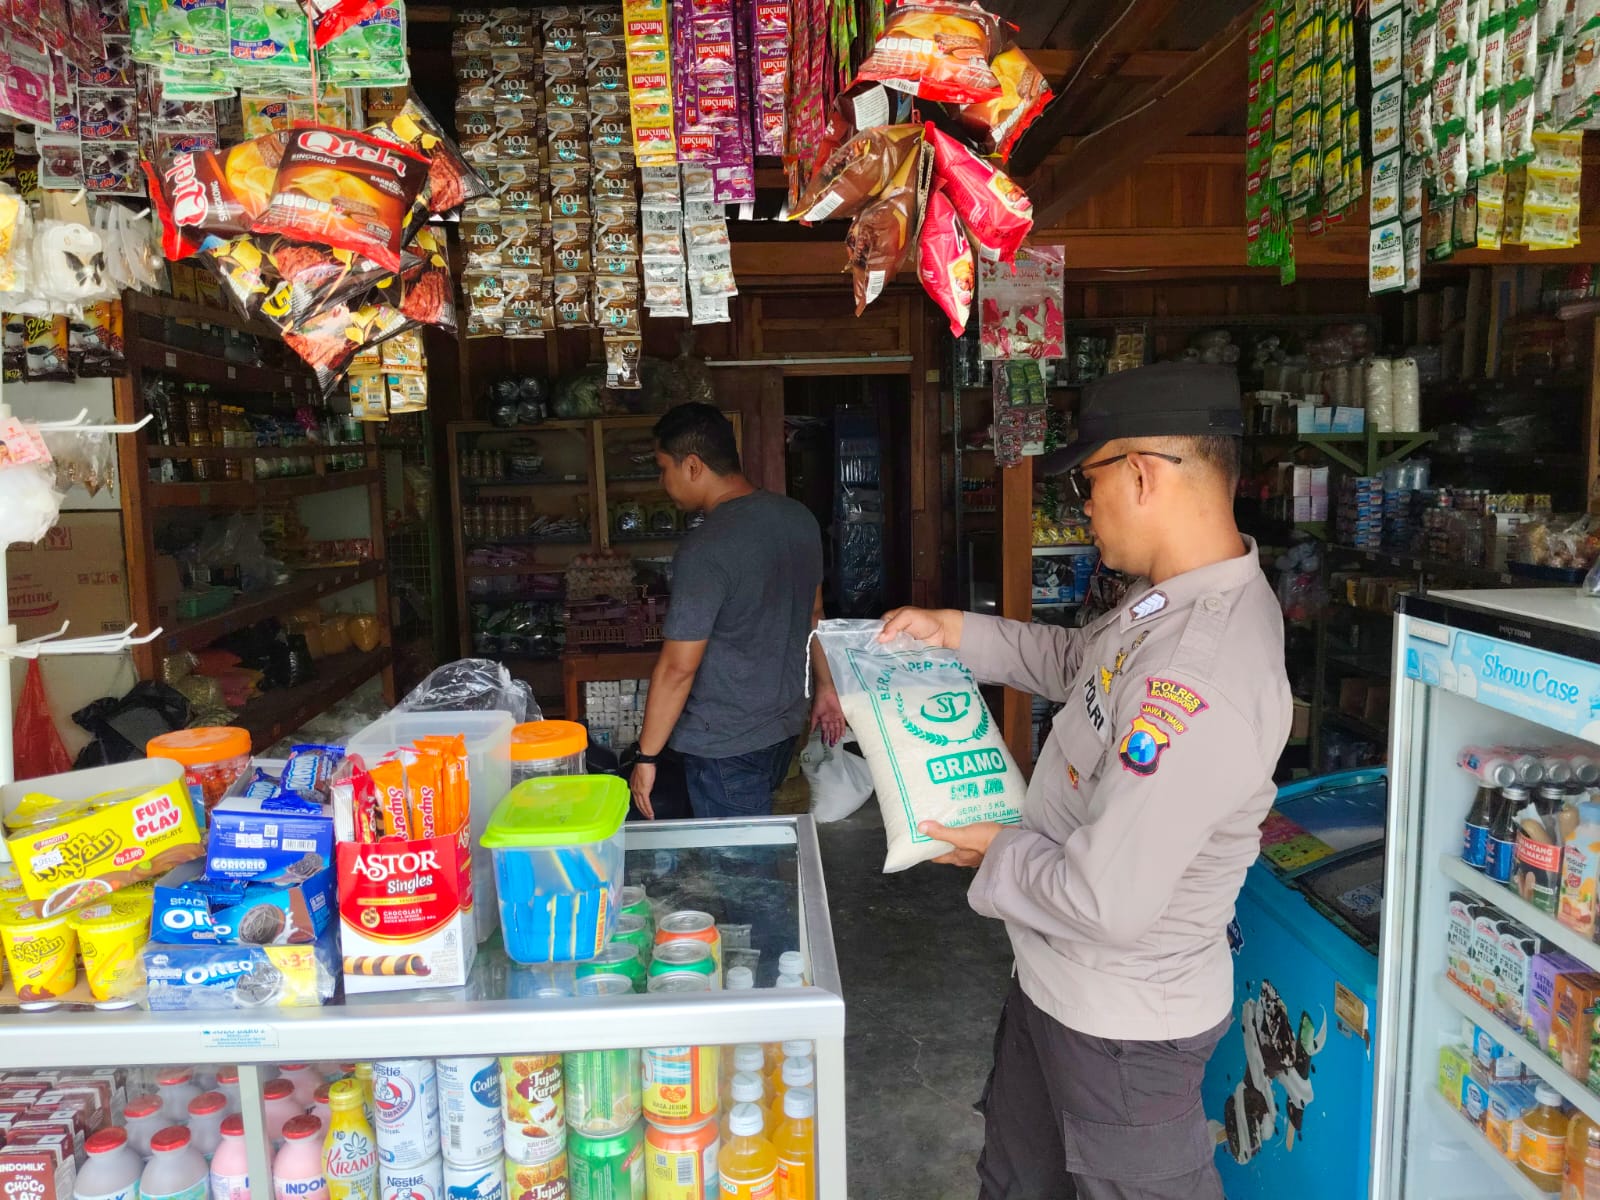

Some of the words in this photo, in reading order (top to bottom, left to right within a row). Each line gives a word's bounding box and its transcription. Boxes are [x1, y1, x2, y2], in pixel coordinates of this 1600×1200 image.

[498, 25, 526, 34] TOP
[549, 28, 577, 38] TOP
[630, 22, 663, 34] NutriSari
[698, 44, 732, 57] NutriSari
[460, 69, 488, 79] TOP
[595, 66, 624, 77] TOP
[501, 79, 529, 90] TOP
[634, 74, 666, 87] NutriSari
[552, 84, 580, 95] TOP
[701, 98, 735, 110] NutriSari
[463, 123, 491, 135] TOP
[599, 123, 626, 134] TOP
[638, 128, 670, 140] NutriSari
[503, 135, 531, 146] TOP
[554, 139, 581, 150] TOP
[681, 136, 714, 149] NutriSari
[298, 131, 406, 177] Qtela
[165, 153, 208, 226] Qtela
[602, 178, 630, 189] TOP
[212, 180, 228, 222] SINGKONG
[506, 191, 534, 201] TOP
[557, 194, 583, 205] TOP
[471, 234, 498, 245] TOP
[606, 233, 632, 244] TOP
[508, 246, 536, 257] TOP
[558, 249, 584, 260] TOP
[511, 300, 537, 310] TOP
[559, 302, 582, 312] TOP
[607, 308, 632, 318] TOP
[1482, 652, 1531, 689] Show
[1532, 669, 1579, 704] Case
[1152, 681, 1201, 708] POLRES
[1084, 674, 1104, 731] POLRI
[1151, 690, 1195, 713] BOJONEGORO
[1142, 705, 1162, 717] JAWA
[1164, 712, 1184, 733] TIMUR
[930, 752, 1004, 781] BRAMO
[136, 797, 170, 821] FUN
[136, 809, 179, 838] PLAY
[145, 827, 183, 847] CHOCOLATE
[351, 850, 442, 882] ASTOR
[387, 874, 433, 894] Singles
[383, 908, 422, 916] CHOCOLATE
[1449, 923, 1471, 940] FRESH
[1452, 933, 1467, 946] MILK
[1475, 940, 1498, 958] FRESH
[1477, 951, 1494, 966] MILK
[185, 960, 253, 985] OREO
[1500, 958, 1522, 977] FRESH
[1502, 968, 1519, 984] MILK
